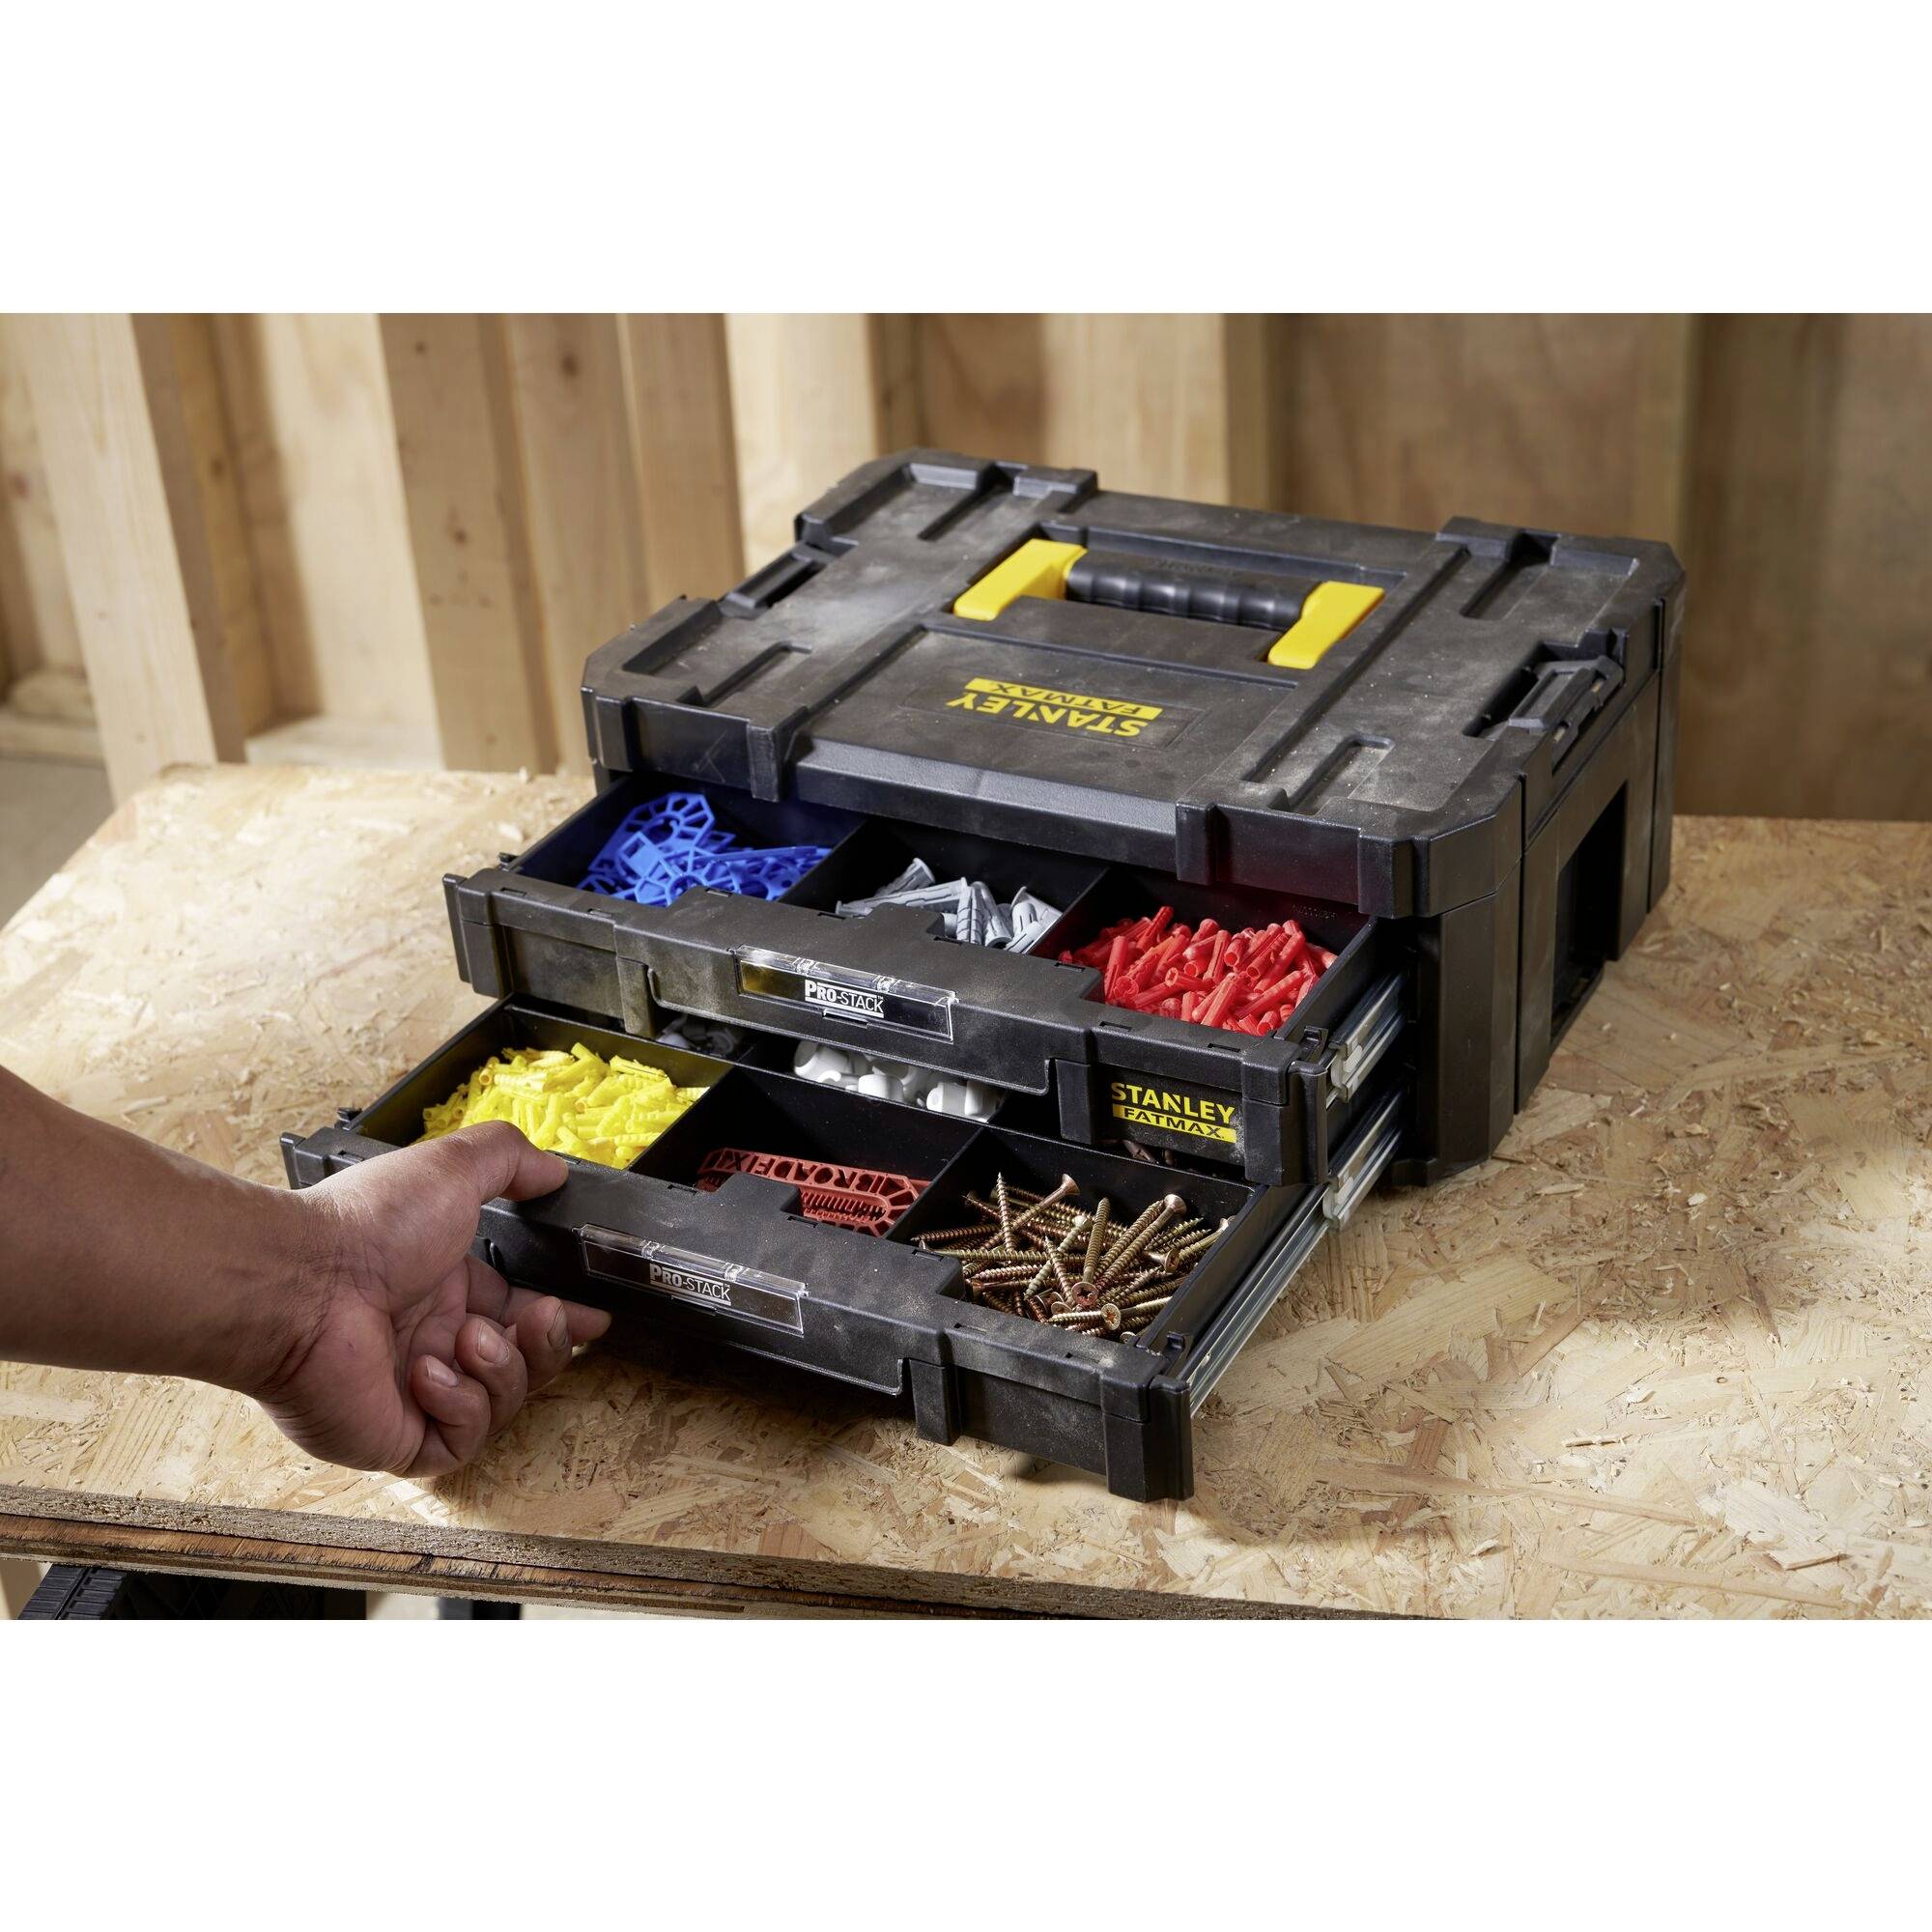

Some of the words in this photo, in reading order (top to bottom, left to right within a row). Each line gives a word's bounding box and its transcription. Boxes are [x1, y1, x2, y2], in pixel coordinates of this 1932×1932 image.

[946, 693, 1148, 737] STANLEY
[991, 683, 1143, 715] FATMAX
[1112, 1082, 1235, 1123] STANLEY
[1124, 1108, 1223, 1138] FATMAX
[724, 1152, 883, 1196] BROADFIX
